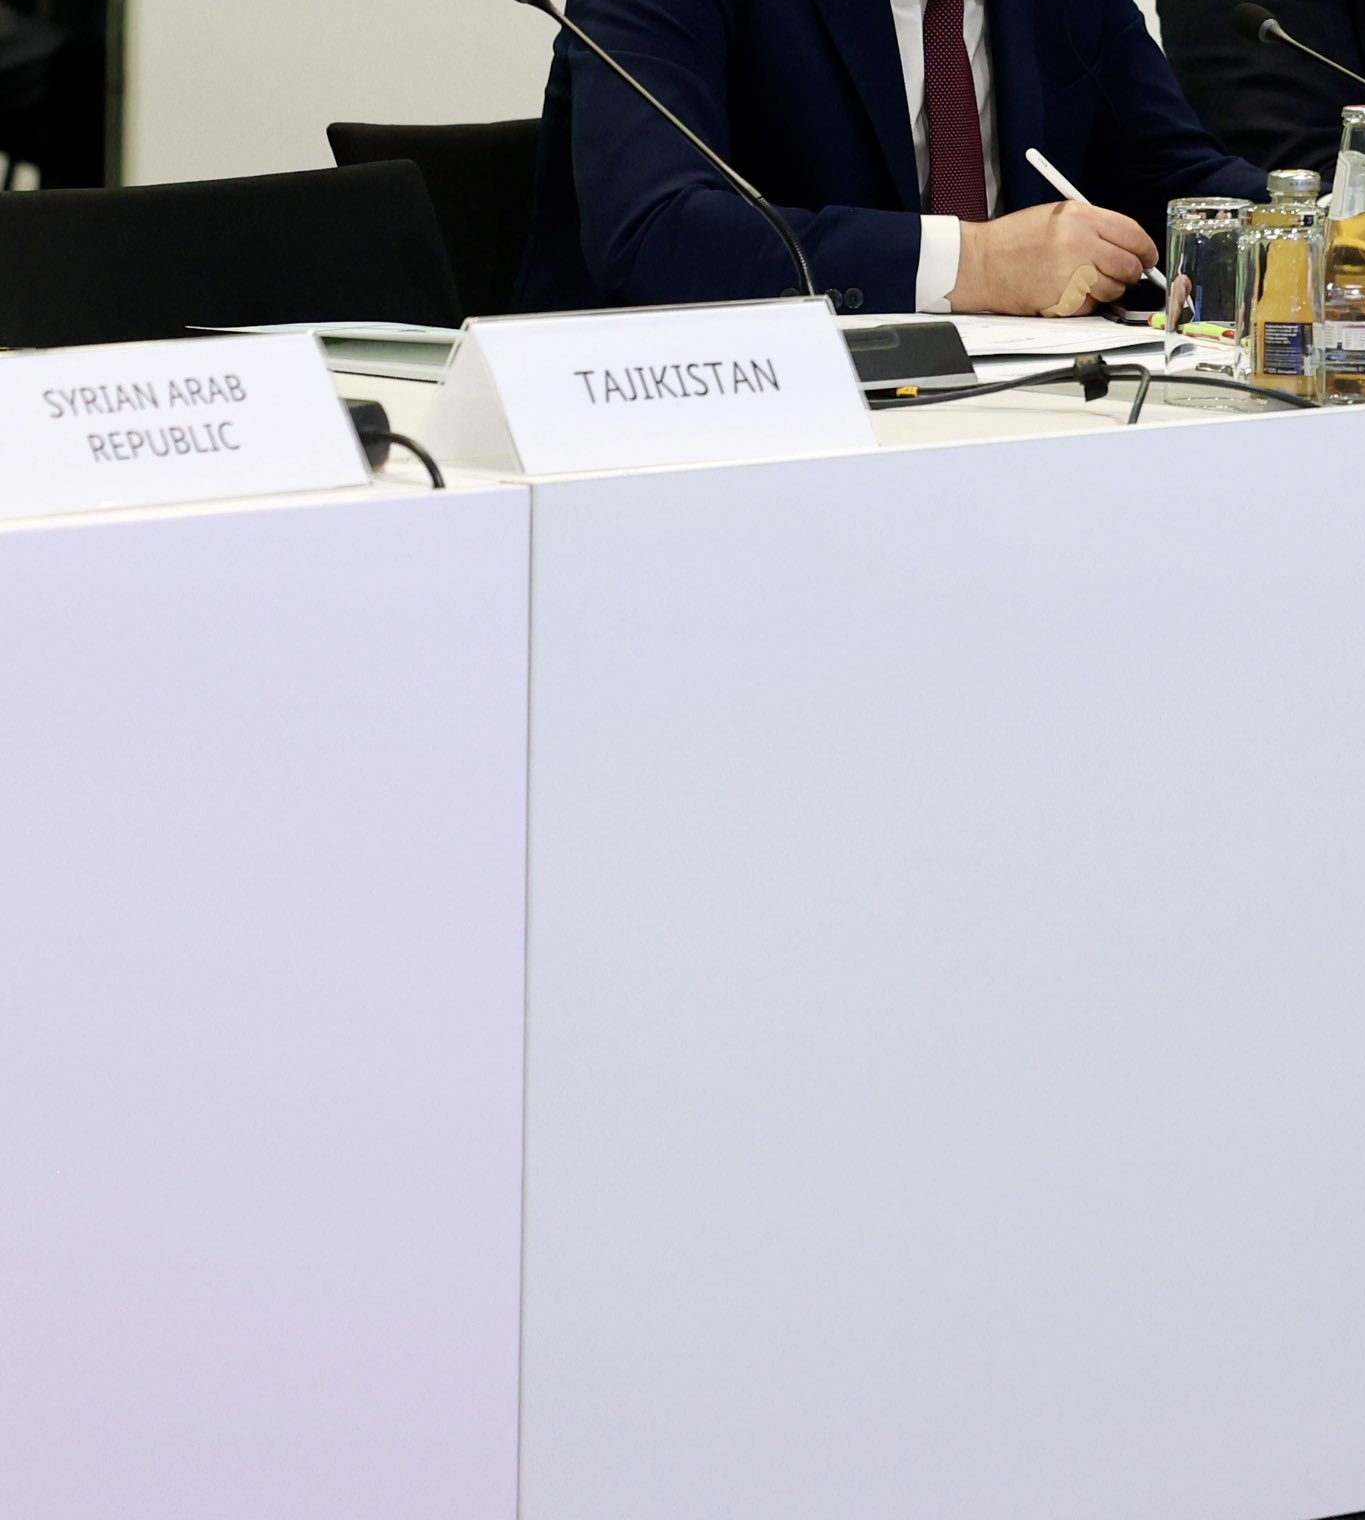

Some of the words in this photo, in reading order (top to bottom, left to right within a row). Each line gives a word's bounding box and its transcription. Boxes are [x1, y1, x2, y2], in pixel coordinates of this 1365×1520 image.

[42, 382, 159, 419] SYRIAN
[168, 374, 247, 407] ARAB
[573, 358, 781, 406] TAJIKISTAN
[87, 421, 241, 462] REPUBLIC
